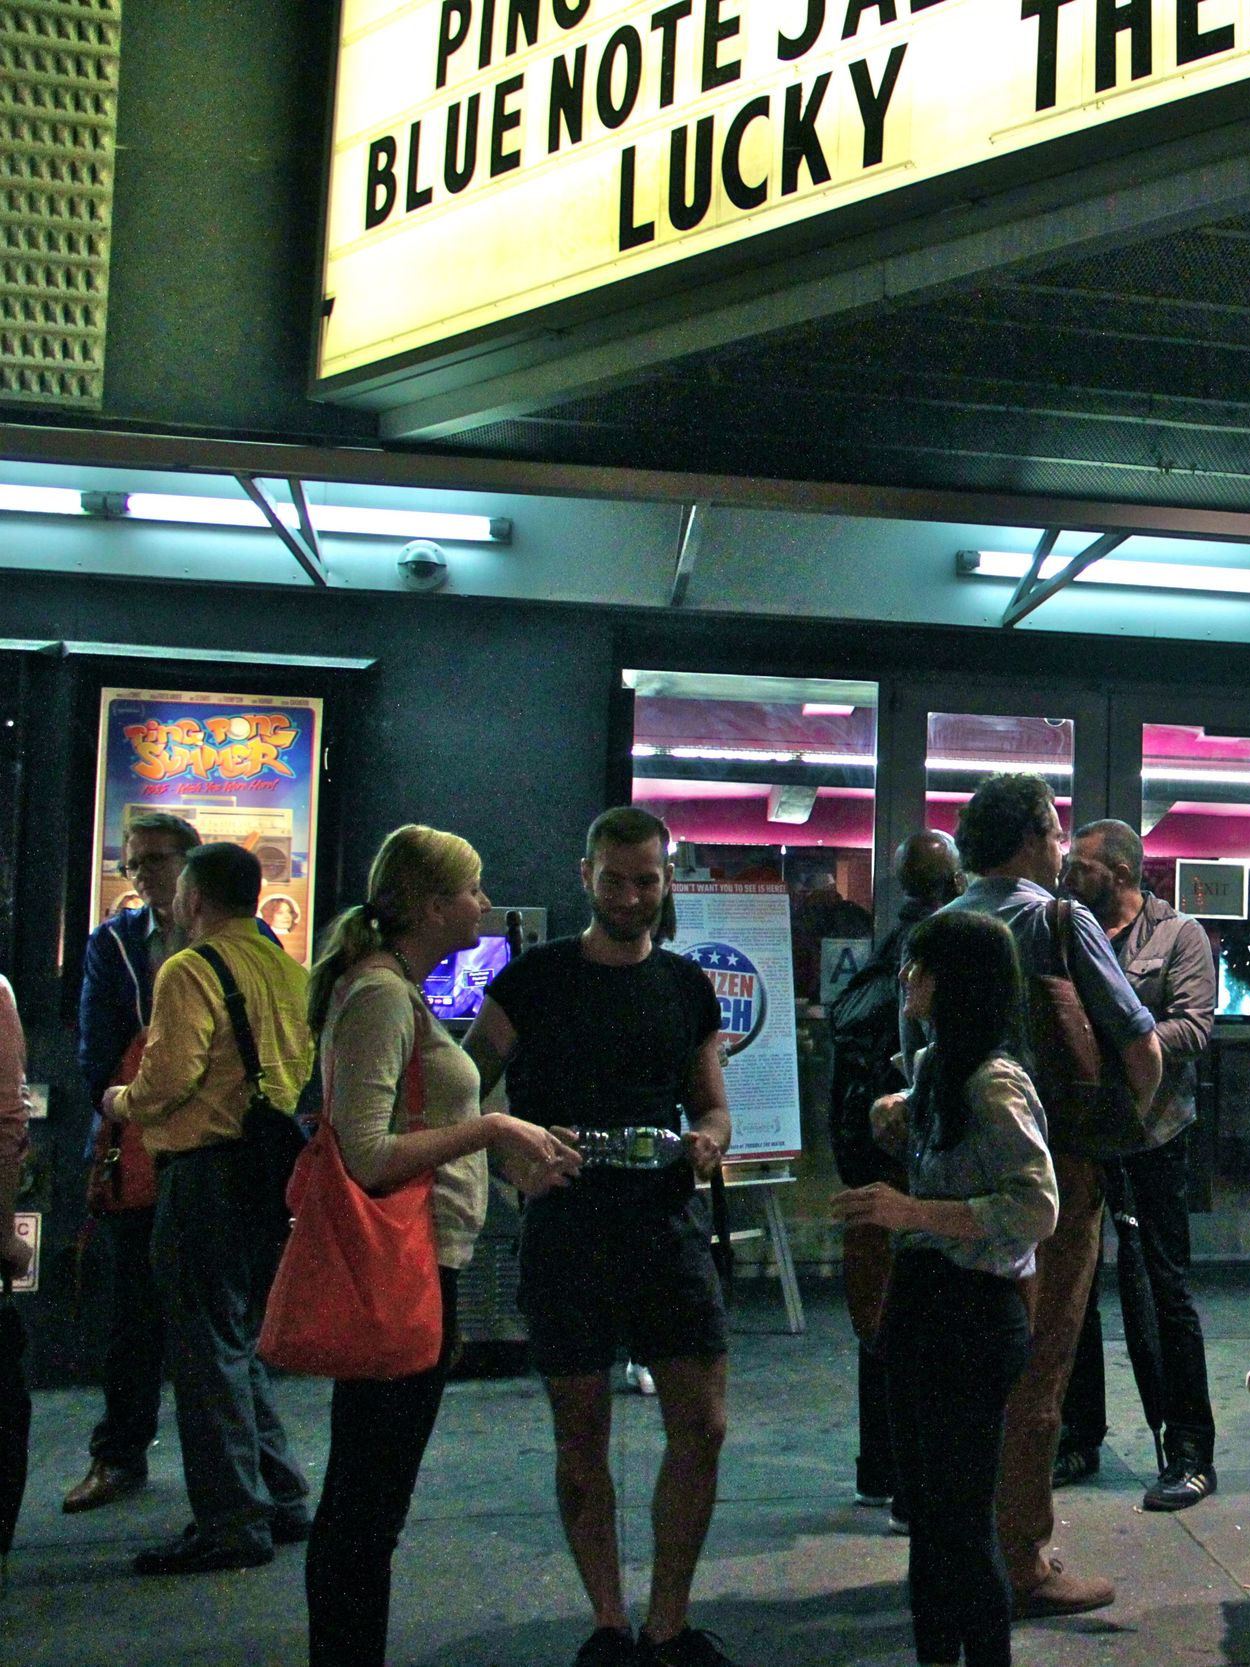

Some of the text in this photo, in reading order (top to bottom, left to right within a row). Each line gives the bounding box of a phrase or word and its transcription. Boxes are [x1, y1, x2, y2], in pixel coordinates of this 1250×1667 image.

[366, 0, 742, 230] BLUE NOTE
[619, 42, 909, 252] LUCKY
[697, 883, 718, 892] WANT
[720, 884, 733, 892] YOU
[734, 884, 744, 892] TO
[745, 884, 757, 892] SEE
[703, 970, 754, 998] IZEN
[716, 997, 752, 1032] CH
